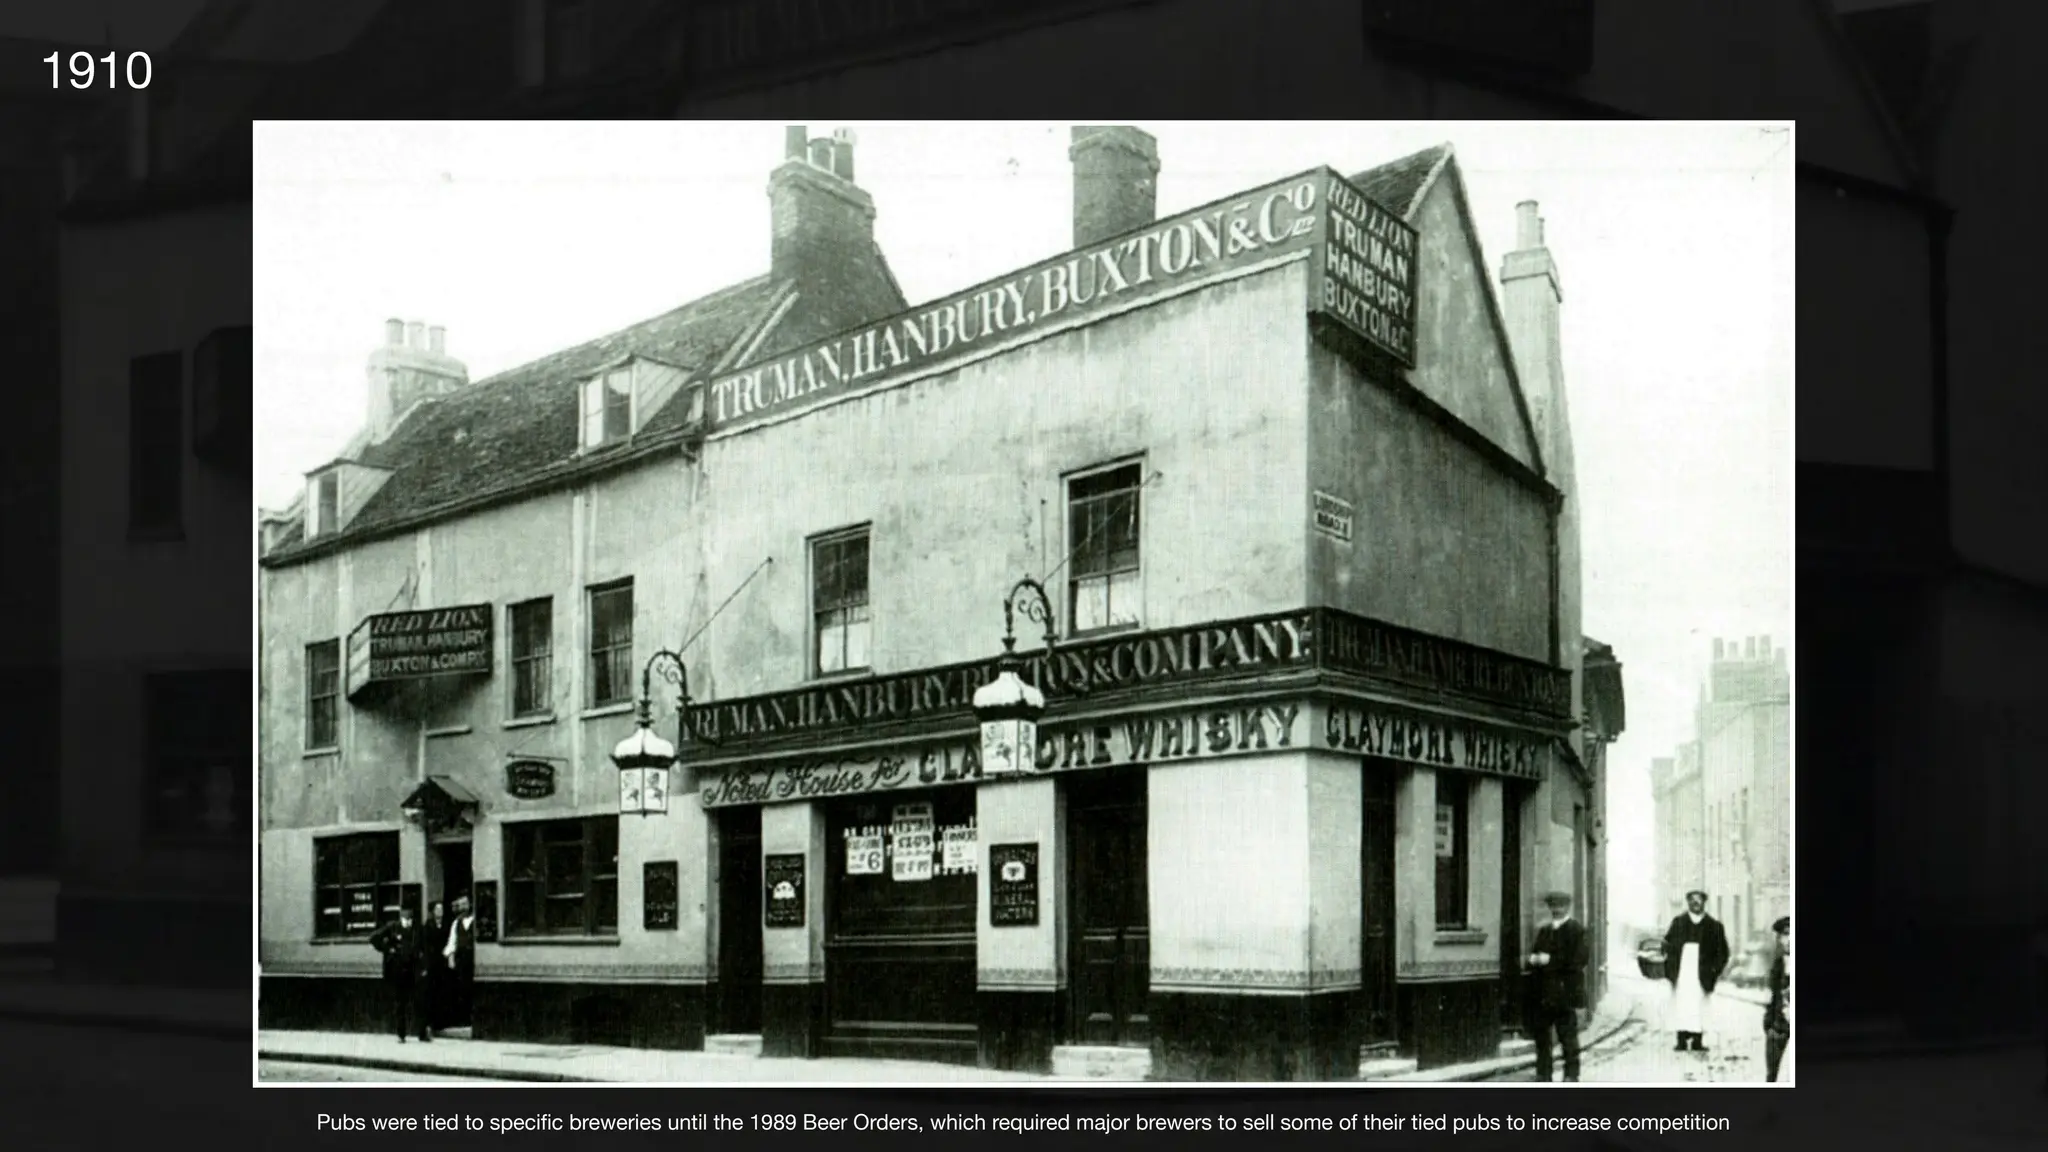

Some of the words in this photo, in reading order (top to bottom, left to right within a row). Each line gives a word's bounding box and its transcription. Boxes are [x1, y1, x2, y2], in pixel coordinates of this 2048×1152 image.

[1327, 178, 1367, 222] RED
[1040, 210, 1226, 318] BUXTON
[1326, 241, 1412, 321] HANBURY
[1330, 209, 1409, 287] TRUMAN
[372, 613, 423, 636] RED
[702, 767, 776, 805] Noted
[776, 762, 864, 799] House
[865, 756, 911, 790] for
[918, 726, 1112, 784] CLAORE
[1125, 702, 1299, 762] WHISKY
[1325, 704, 1455, 765] CLAYMORE
